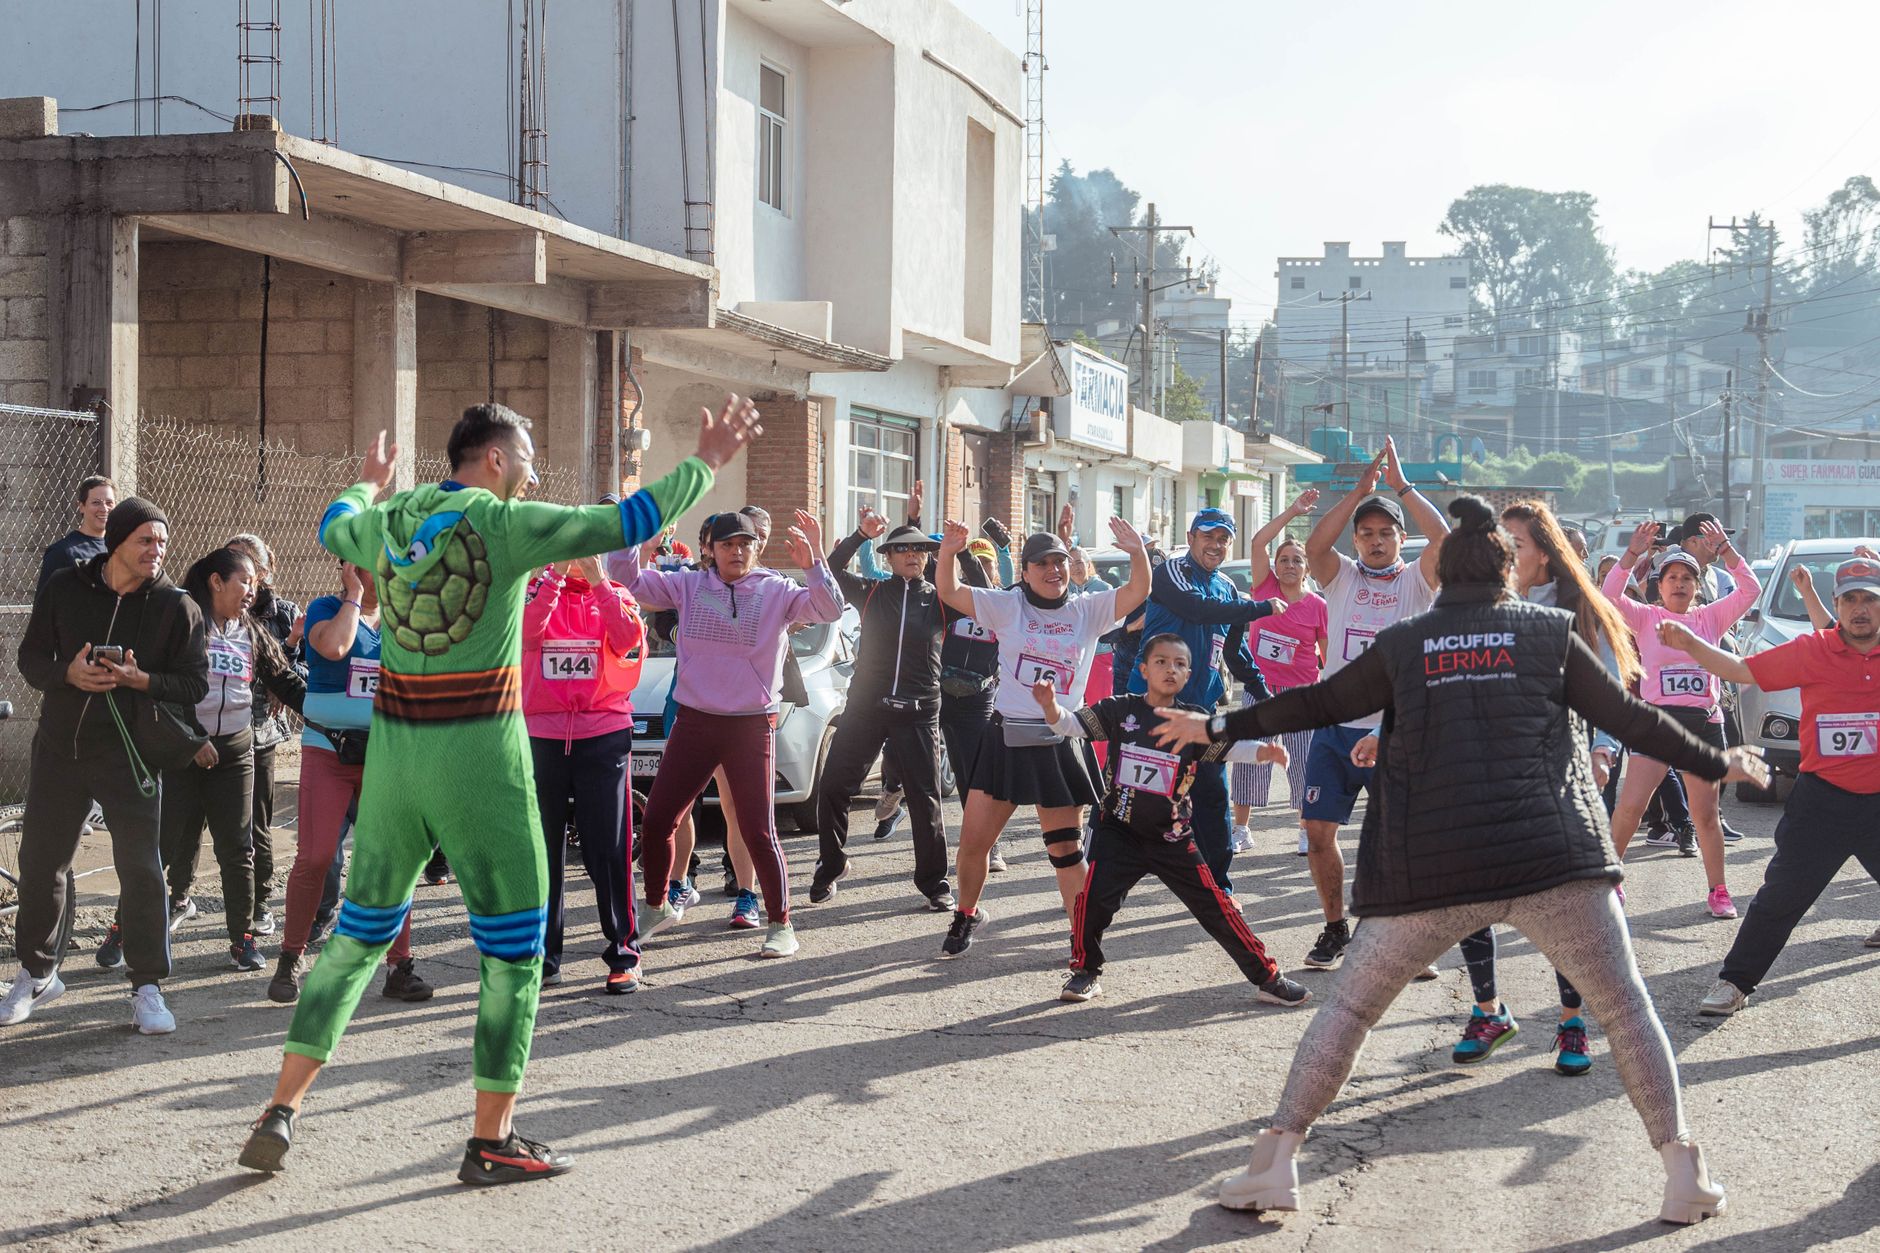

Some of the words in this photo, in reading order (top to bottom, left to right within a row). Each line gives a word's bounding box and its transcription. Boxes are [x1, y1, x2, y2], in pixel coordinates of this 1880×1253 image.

[1075, 361, 1124, 421] FARMACIA
[1781, 464, 1808, 479] SUPER
[1811, 464, 1856, 479] FARMACIA
[1270, 645, 1281, 658] 3
[1424, 632, 1515, 653] IMCUFIDE
[209, 653, 243, 672] 139
[549, 657, 591, 675] 144
[1425, 647, 1515, 675] LERMA
[1667, 677, 1704, 691] 140
[1832, 732, 1863, 751] 97
[1133, 765, 1158, 784] 17
